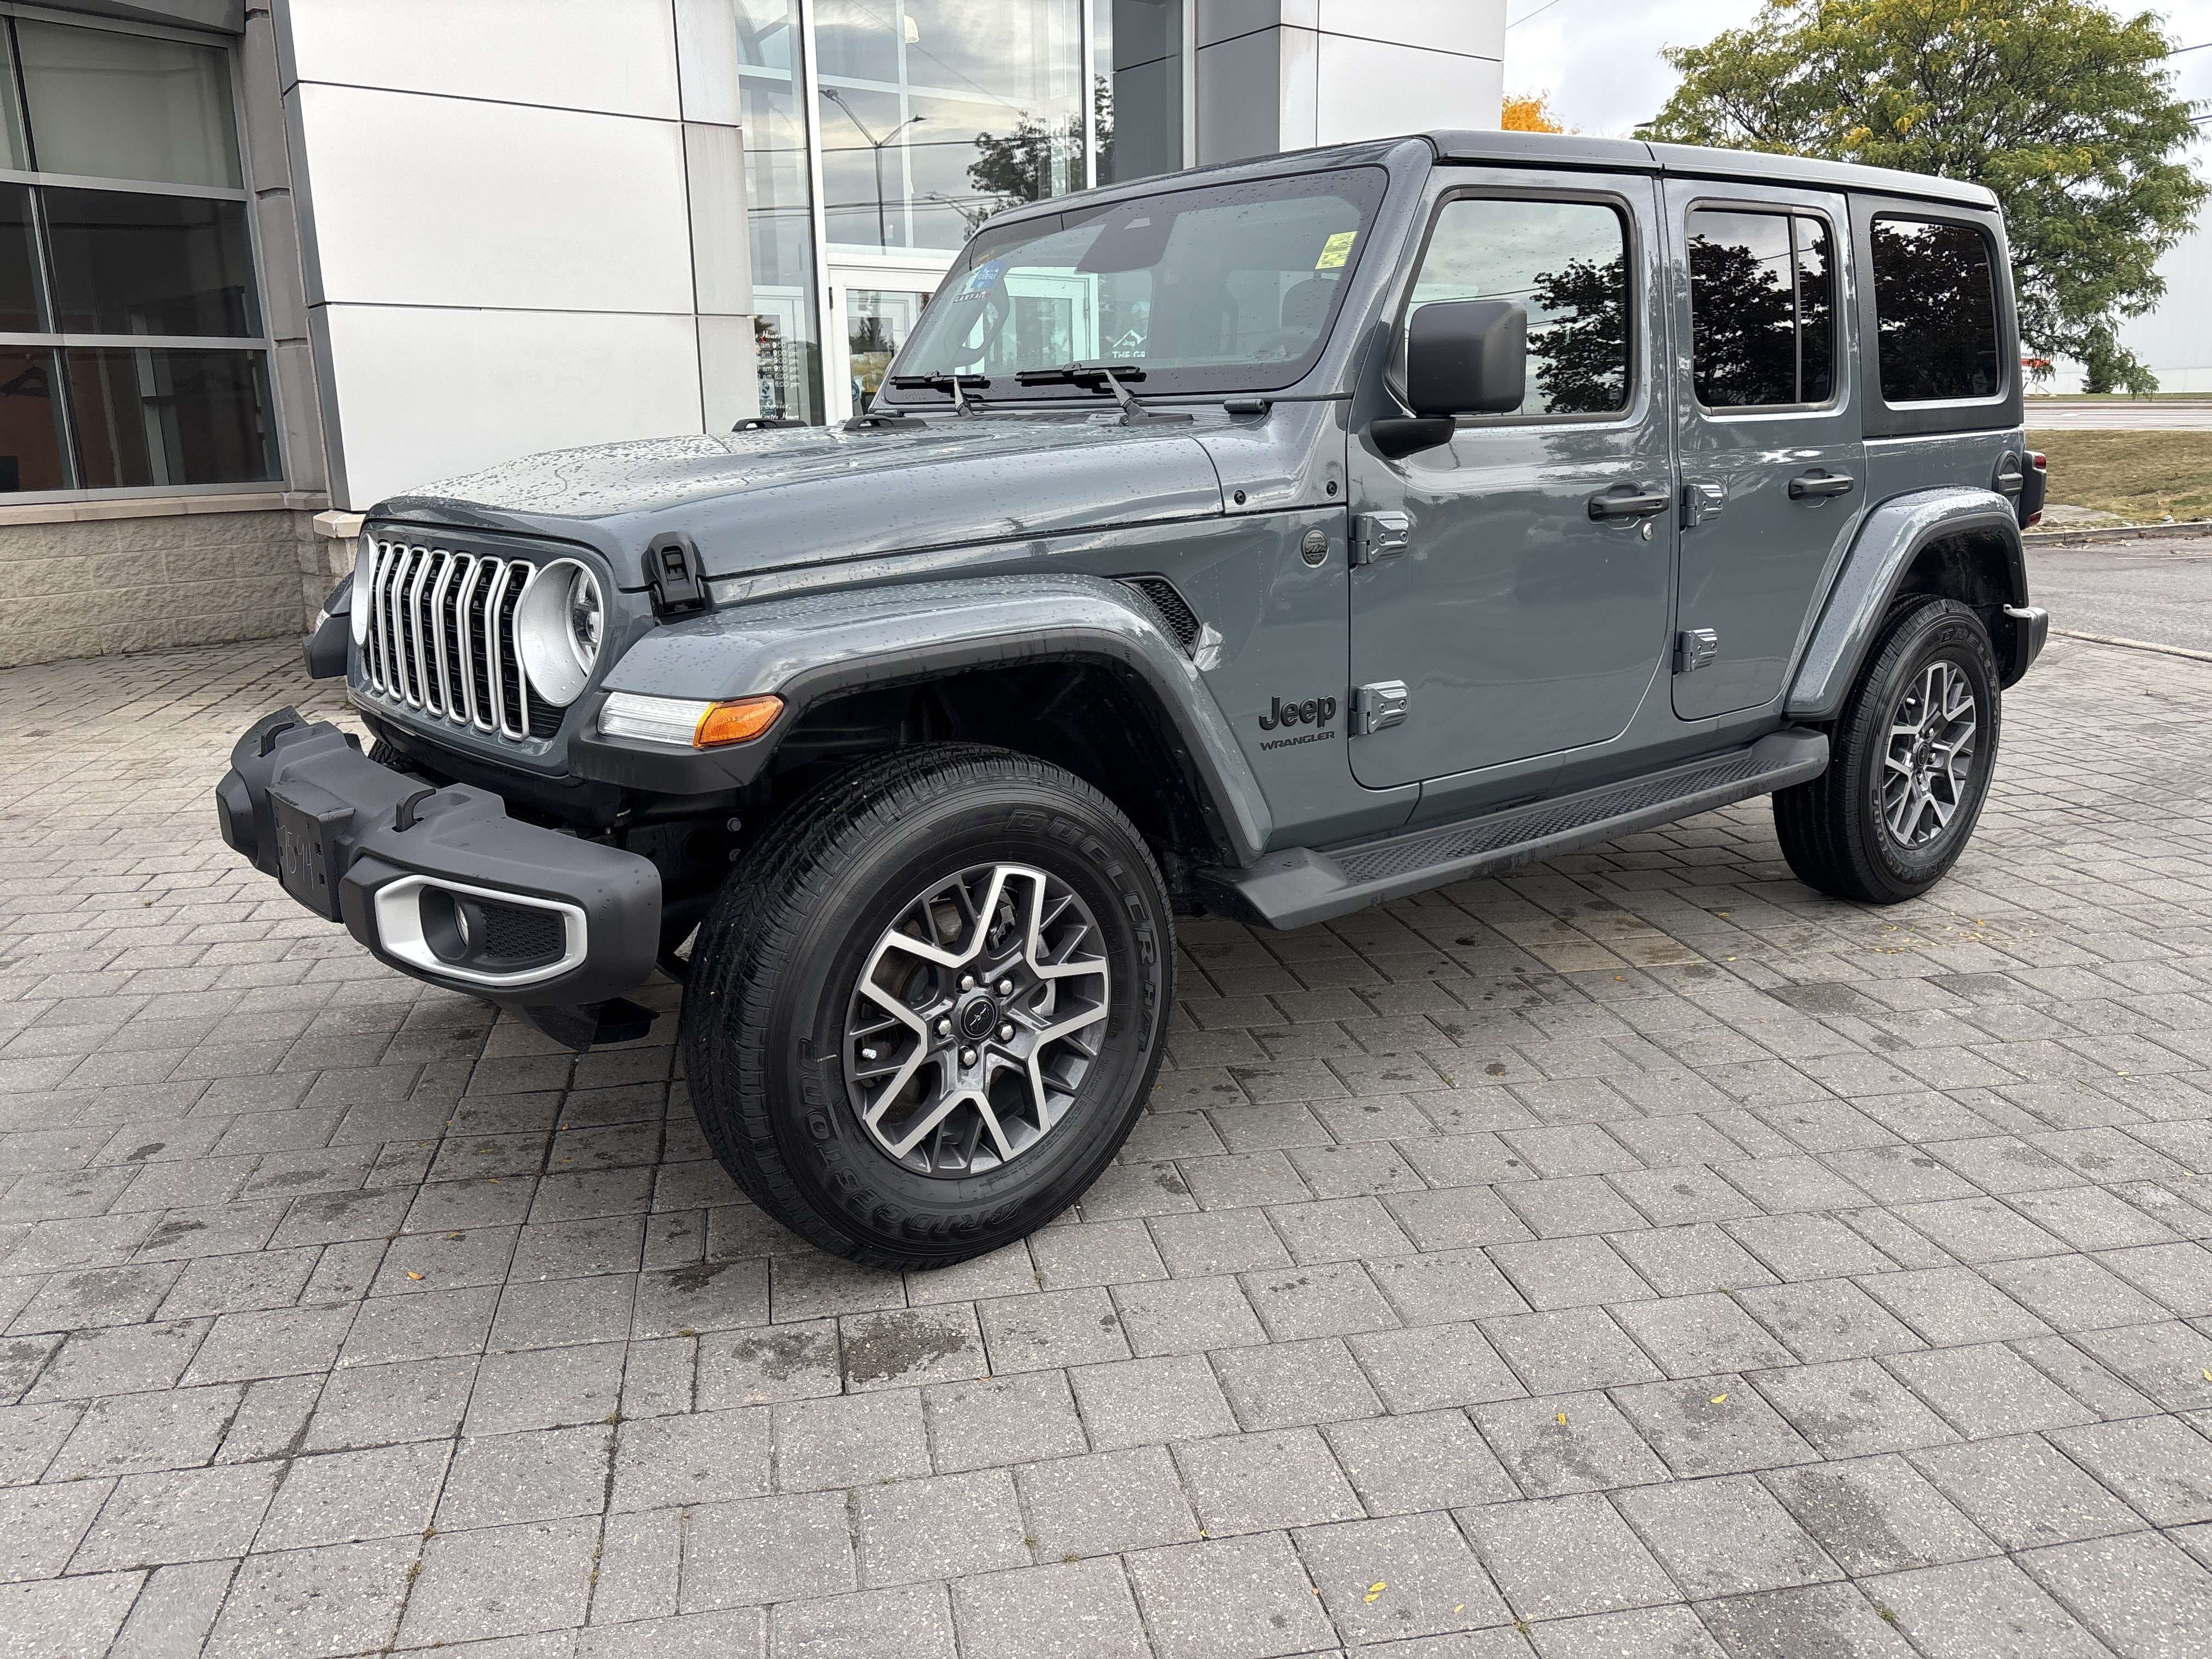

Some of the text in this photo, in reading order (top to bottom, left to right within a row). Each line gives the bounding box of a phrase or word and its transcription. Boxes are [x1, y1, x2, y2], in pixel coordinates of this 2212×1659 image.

[1259, 695, 1336, 730] Jeep
[1260, 731, 1335, 751] WRANGLER
[1005, 808, 1158, 967] DUELER
[798, 1037, 1024, 1235] BRIDGESTONE
